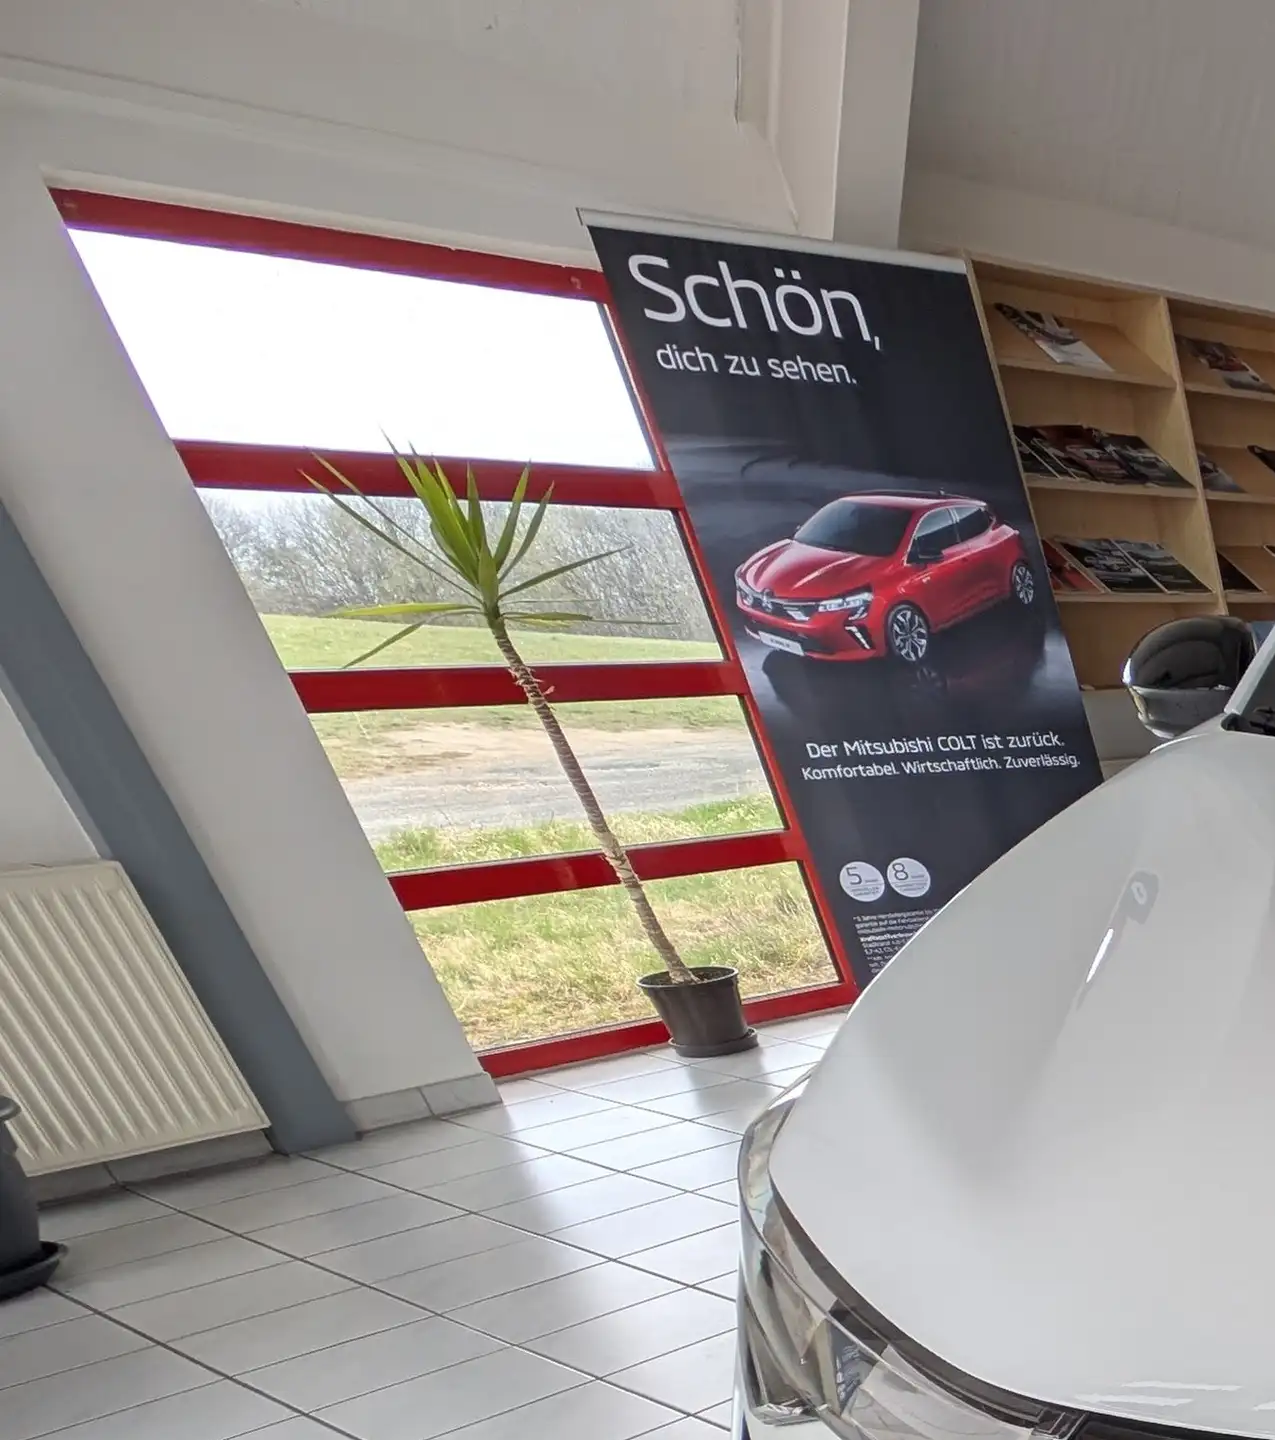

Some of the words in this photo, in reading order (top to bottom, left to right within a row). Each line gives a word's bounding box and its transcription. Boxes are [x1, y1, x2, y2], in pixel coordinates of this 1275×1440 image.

[628, 254, 882, 350] Schön,
[656, 344, 718, 372] dich
[724, 354, 760, 376] zu
[767, 355, 857, 384] sehen.
[805, 742, 838, 758] Der
[843, 737, 934, 756] Mitsubishi
[938, 735, 977, 751] COLT
[981, 733, 1004, 749] ist
[1006, 731, 1065, 748] zurück.
[801, 762, 900, 780] Komfortabel.
[901, 757, 1002, 774] Wirtschaftlich.
[1004, 753, 1080, 769] Zuverlässig.
[845, 866, 863, 885] 5
[892, 862, 909, 881] 8
